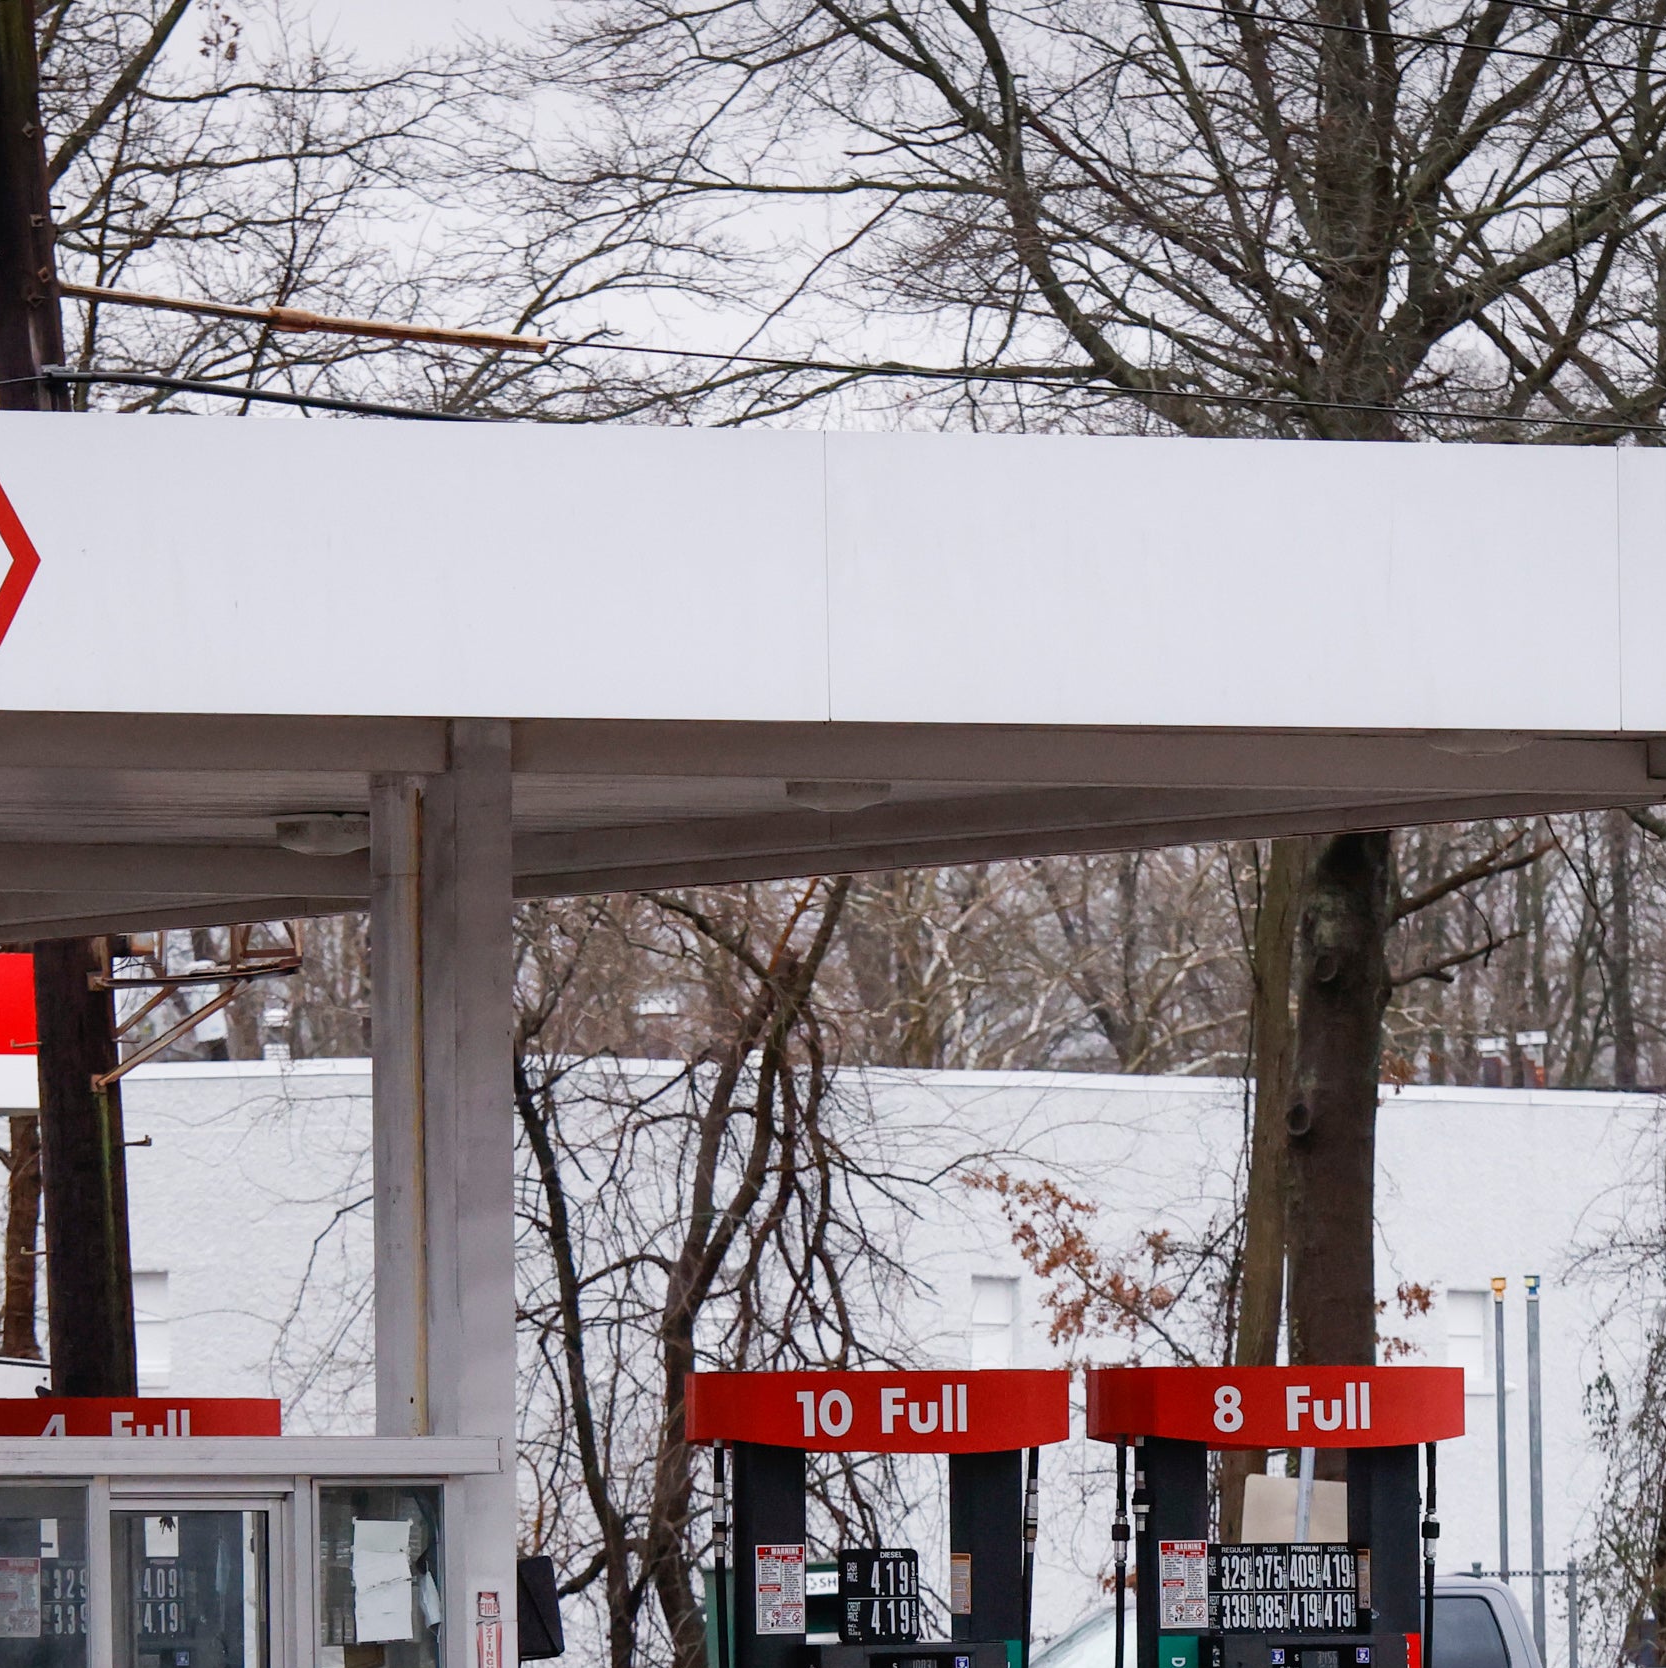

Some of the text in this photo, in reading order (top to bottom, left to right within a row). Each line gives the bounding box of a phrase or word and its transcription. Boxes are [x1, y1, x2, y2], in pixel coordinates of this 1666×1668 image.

[796, 1383, 968, 1438] 10 Full
[1213, 1381, 1371, 1433] 8 Full
[110, 1409, 191, 1437] Full
[771, 1547, 800, 1555] WARNING
[879, 1551, 904, 1559] DIESEL
[1173, 1543, 1202, 1551] WARNING
[1221, 1546, 1252, 1554] REGULAR
[1290, 1545, 1319, 1553] PREMIUM
[871, 1561, 909, 1596] 4.19
[478, 1602, 500, 1615] FIRE
[871, 1600, 910, 1635] 4.19
